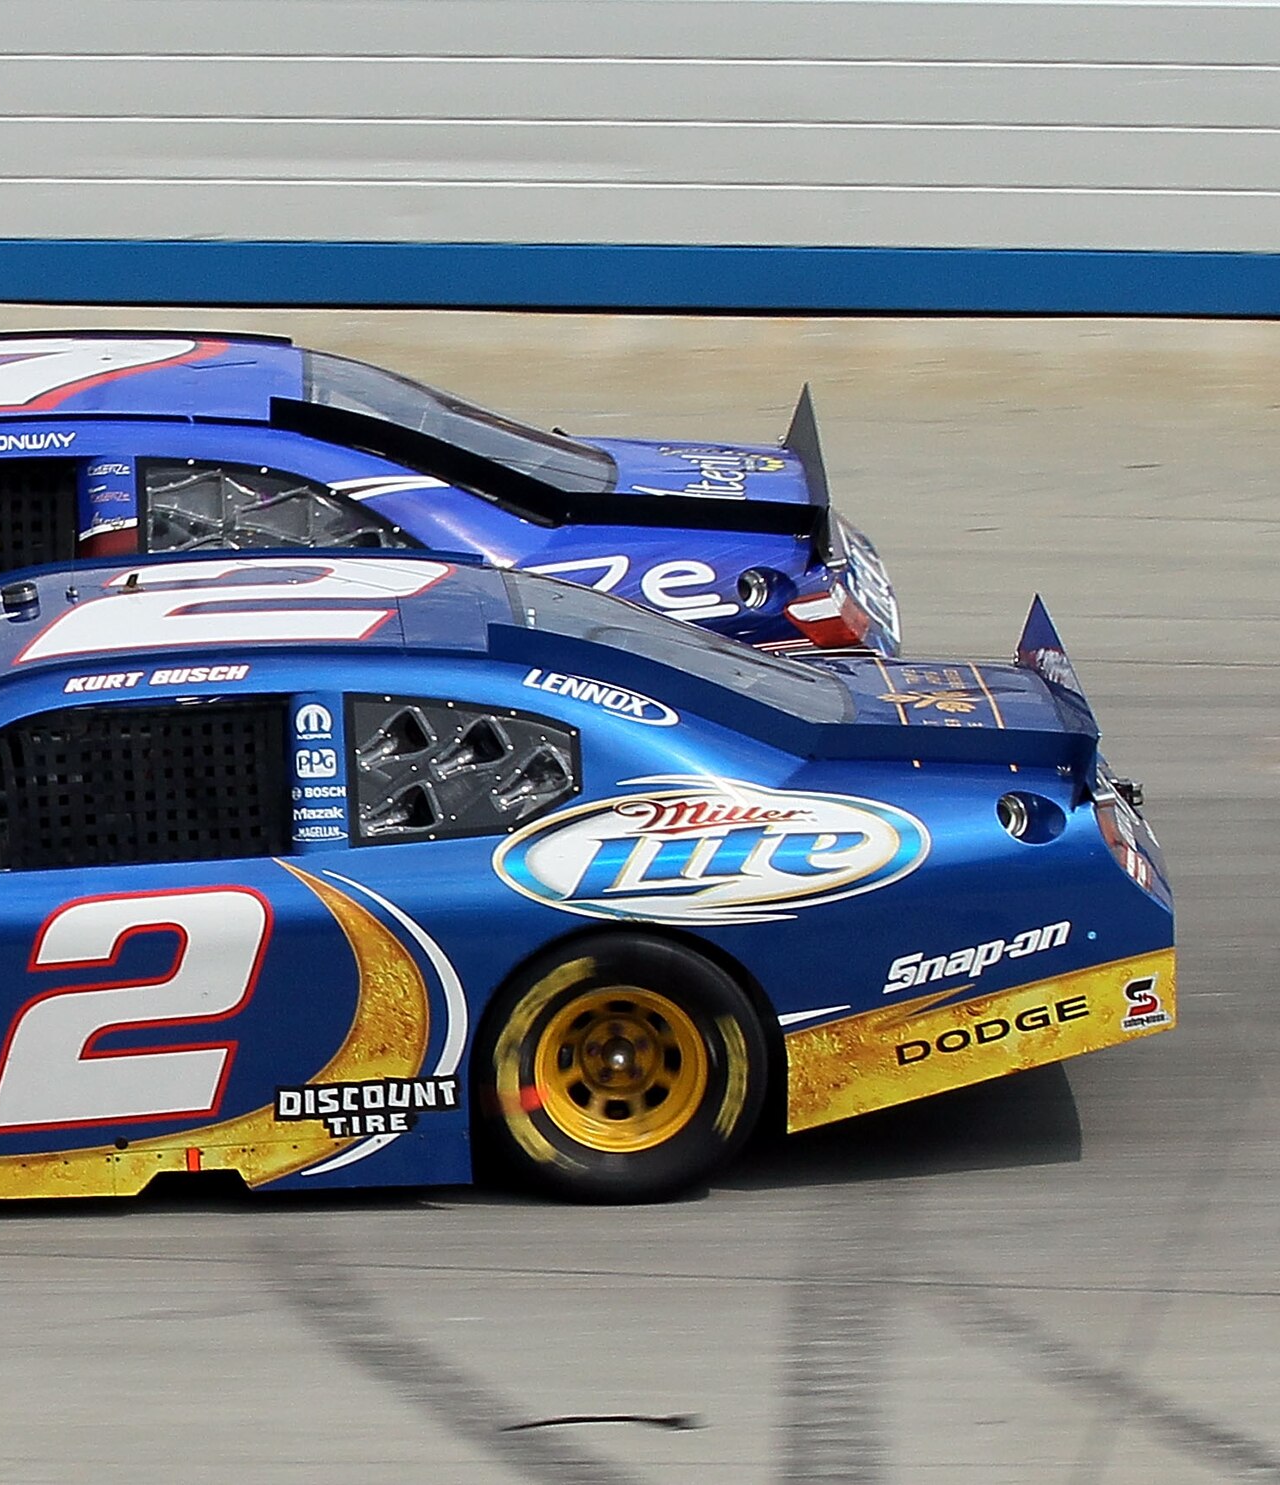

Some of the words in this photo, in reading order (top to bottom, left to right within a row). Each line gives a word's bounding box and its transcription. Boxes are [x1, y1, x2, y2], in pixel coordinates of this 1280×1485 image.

[12, 557, 457, 666] 2
[64, 672, 144, 693] KURT
[149, 665, 250, 686] BUSCH
[522, 668, 650, 717] LENNOX
[298, 750, 335, 773] PPG
[304, 786, 346, 798] BOSCH
[293, 806, 344, 821] Mazak
[613, 800, 816, 834] Miller
[560, 826, 870, 901] Lite
[882, 920, 1071, 995] Snap-on
[894, 995, 1091, 1066] DODGE
[279, 1080, 456, 1117] DISCOUNT
[328, 1113, 409, 1134] TIRE
